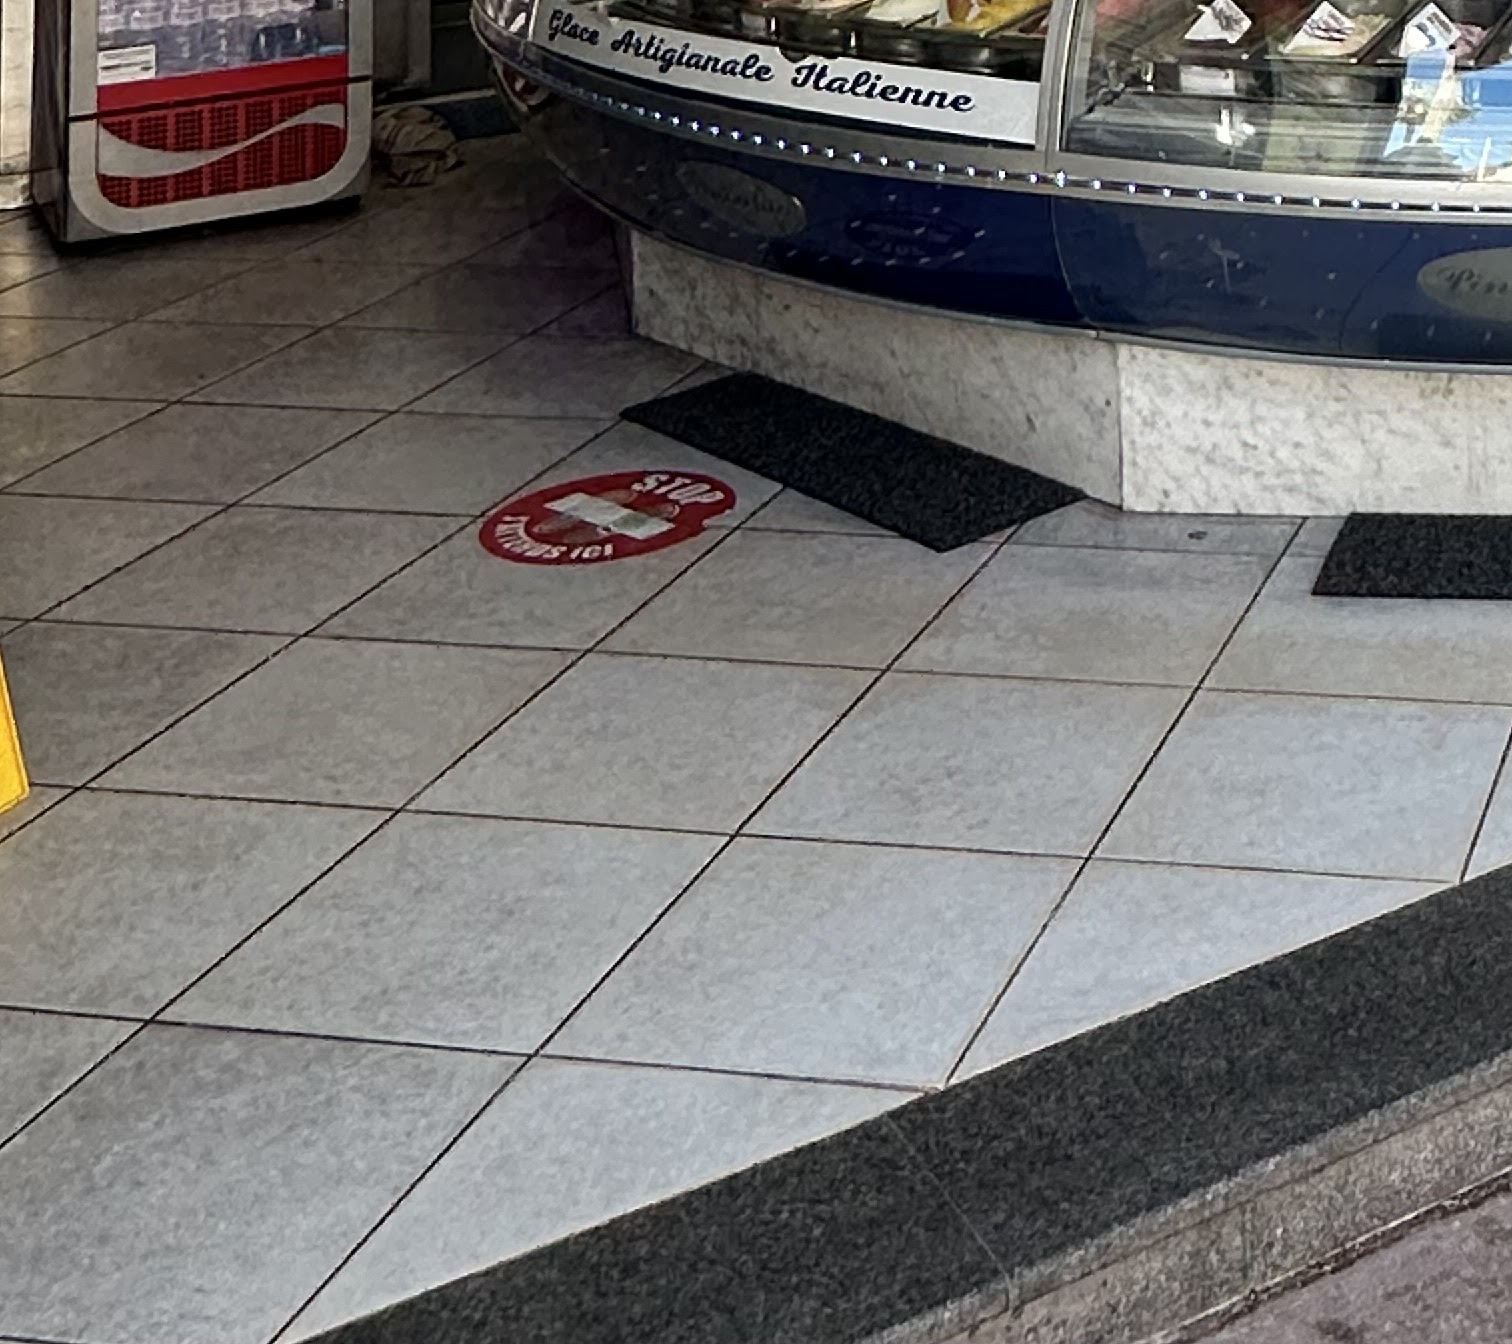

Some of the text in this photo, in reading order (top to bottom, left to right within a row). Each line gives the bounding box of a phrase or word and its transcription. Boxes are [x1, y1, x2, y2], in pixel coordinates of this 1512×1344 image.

[611, 30, 775, 82] Artigianale
[791, 62, 975, 112] Italienne
[631, 474, 726, 505] STOP
